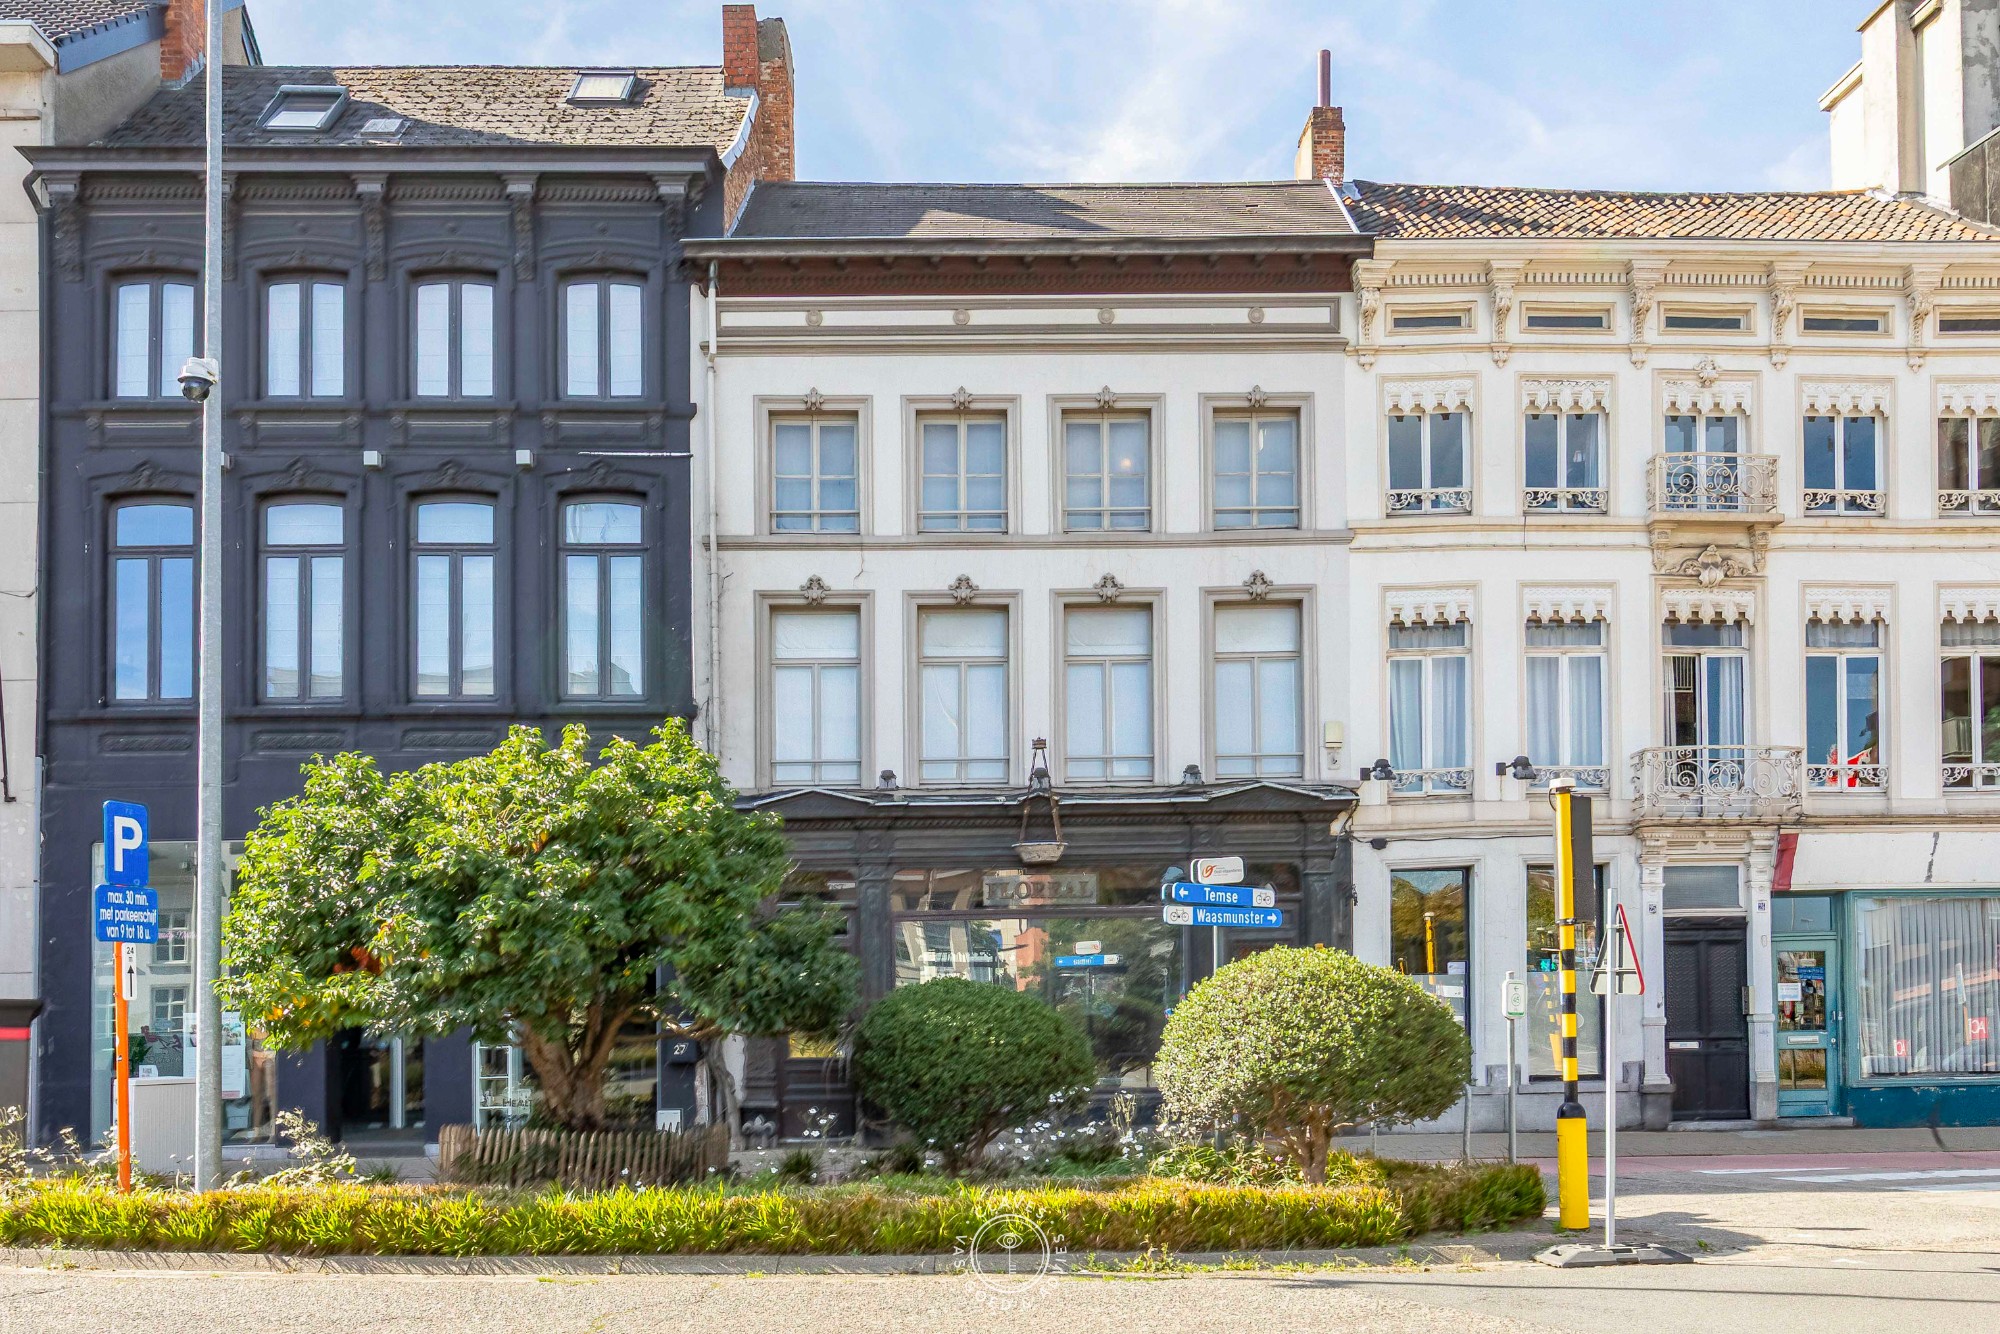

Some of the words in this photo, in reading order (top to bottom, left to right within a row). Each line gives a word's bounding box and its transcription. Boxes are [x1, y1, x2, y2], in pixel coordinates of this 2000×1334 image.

[114, 815, 143, 872] P
[107, 891, 125, 904] max.
[126, 890, 134, 905] 30
[135, 891, 149, 906] min.
[1204, 887, 1239, 903] Temse
[100, 906, 114, 921] met
[115, 907, 157, 926] parkeerschijf
[1197, 908, 1265, 925] Waasmunster
[106, 926, 120, 938] van
[120, 924, 125, 938] 9
[126, 924, 135, 939] tot
[137, 925, 144, 940] 18
[144, 928, 151, 940] u.
[126, 946, 134, 955] 24
[673, 1043, 687, 1056] 27
